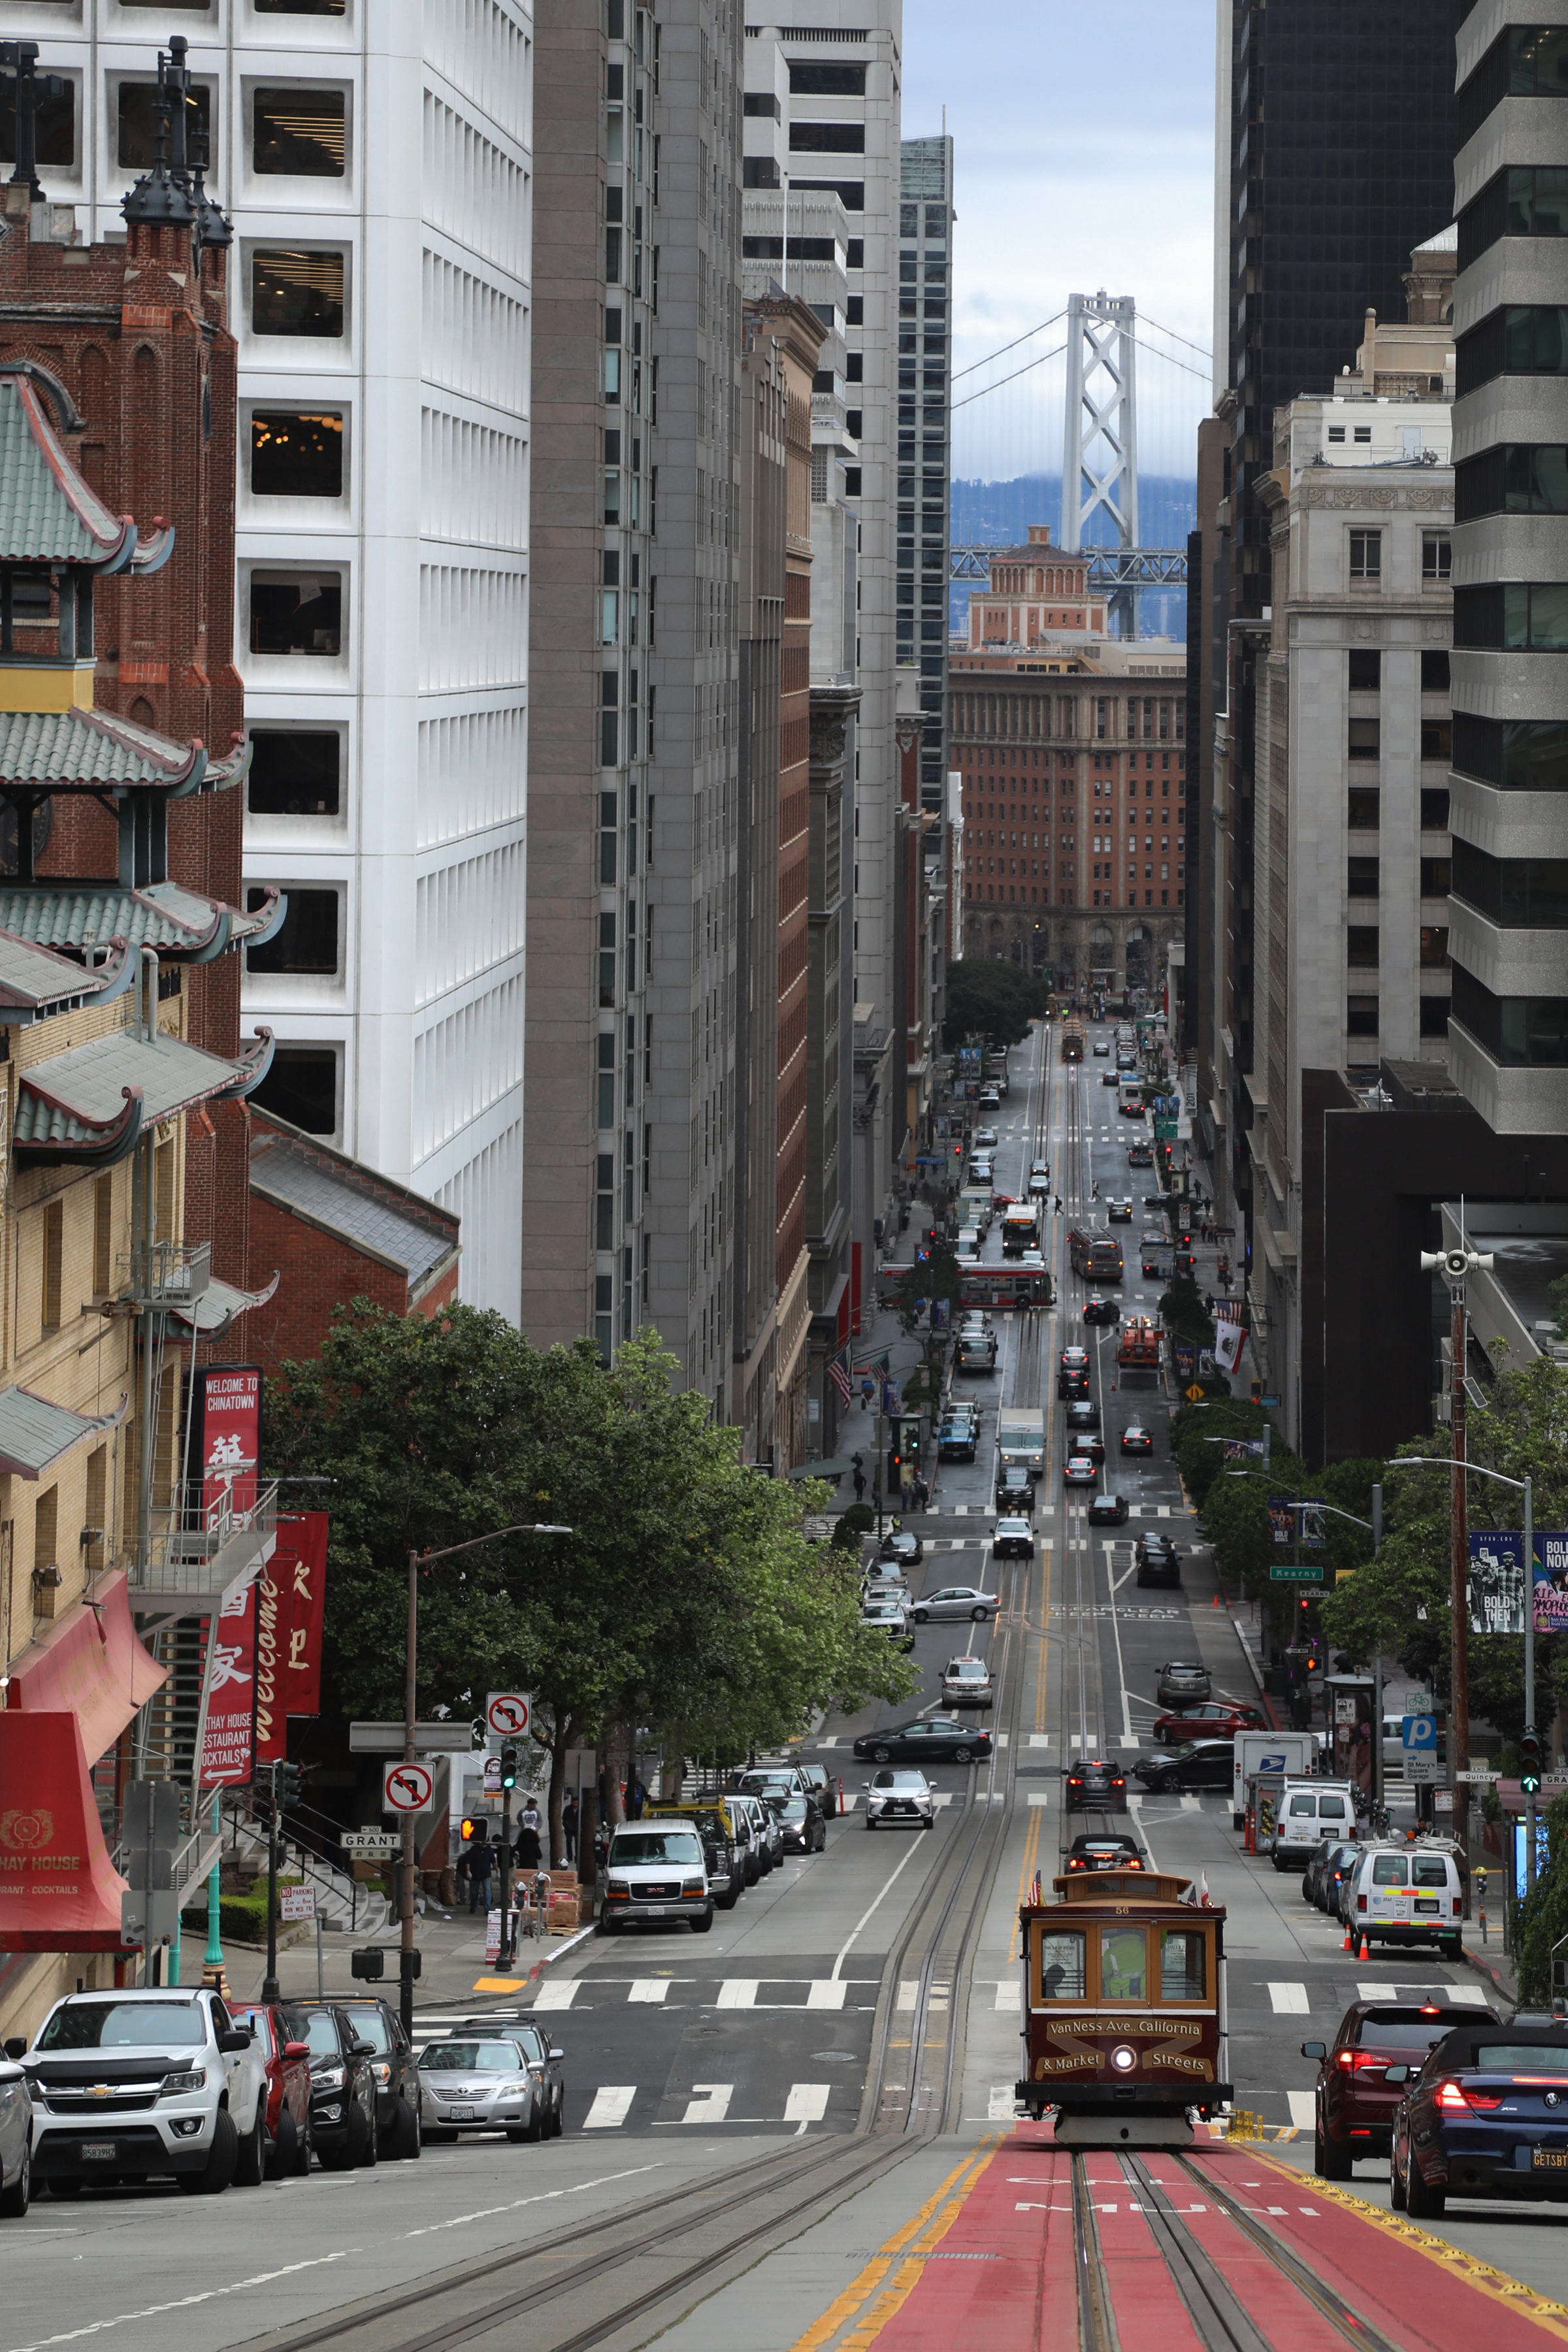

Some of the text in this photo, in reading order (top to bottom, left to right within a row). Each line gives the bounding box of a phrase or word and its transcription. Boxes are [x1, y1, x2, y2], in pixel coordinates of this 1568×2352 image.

[206, 1377, 257, 1394] WELCOME TO
[208, 1394, 255, 1412] CHINATOWN
[1276, 1569, 1316, 1579] Kearny
[1484, 1595, 1511, 1609] BOLD
[1484, 1609, 1511, 1622] THEN
[227, 1712, 252, 1728] HOUSE
[203, 1730, 250, 1749] ESTAURANT
[202, 1748, 240, 1767] OCKTAILS
[346, 1836, 397, 1846] GRANT
[32, 1855, 80, 1870] HOUSE
[0, 1885, 78, 1895] RANT COCKTAILS
[282, 1887, 291, 1897] NO
[1050, 2023, 1071, 2034] Van
[1073, 2021, 1102, 2033] Ness
[1139, 2021, 1200, 2036] California
[1043, 2053, 1204, 2071] & Market Streets
